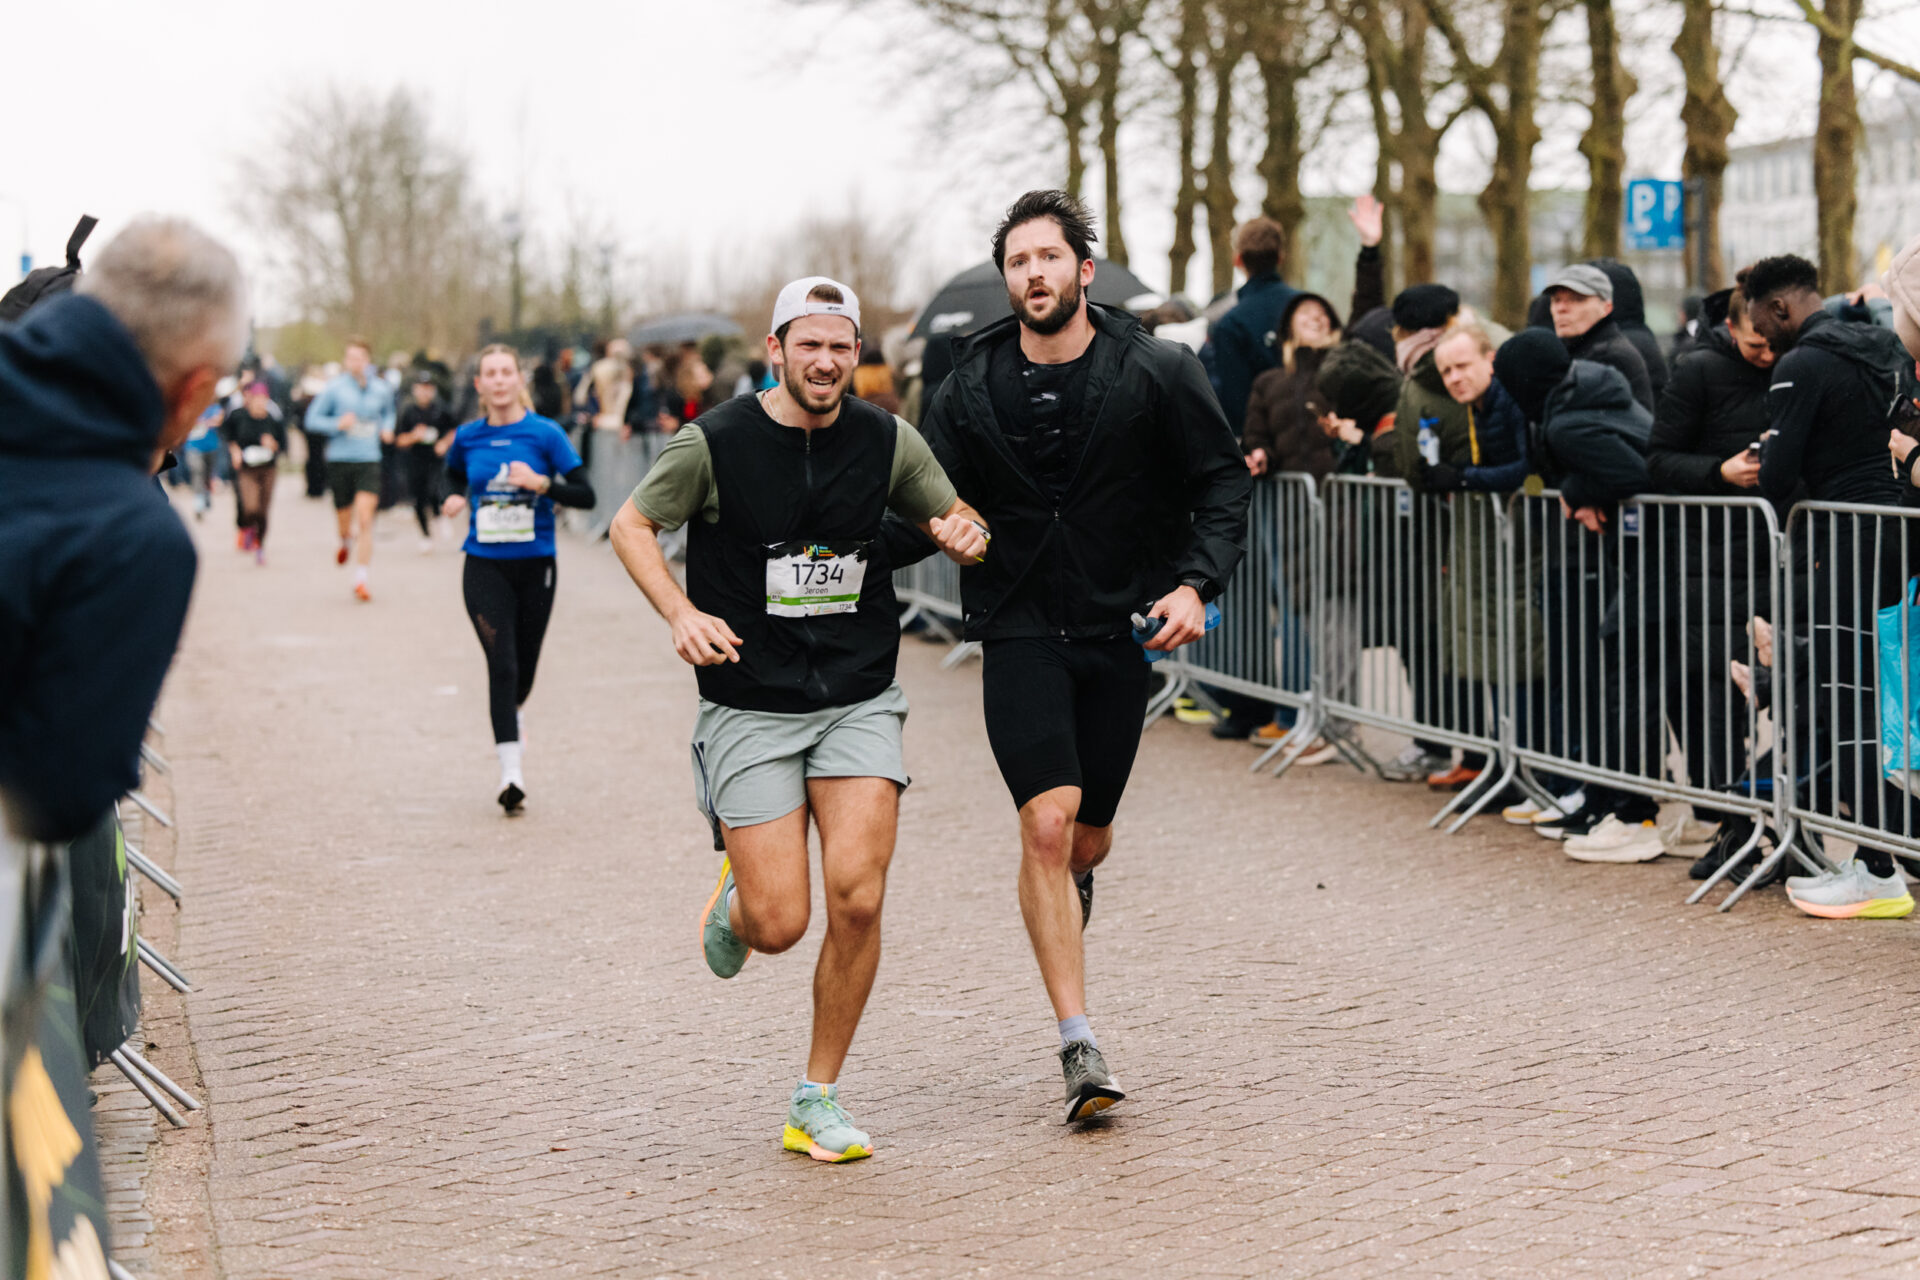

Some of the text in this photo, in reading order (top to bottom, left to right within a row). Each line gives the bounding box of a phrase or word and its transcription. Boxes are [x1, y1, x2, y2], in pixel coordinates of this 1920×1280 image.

[792, 563, 844, 586] 1734
[804, 587, 829, 595] Jeroen
[839, 603, 852, 611] 1734
